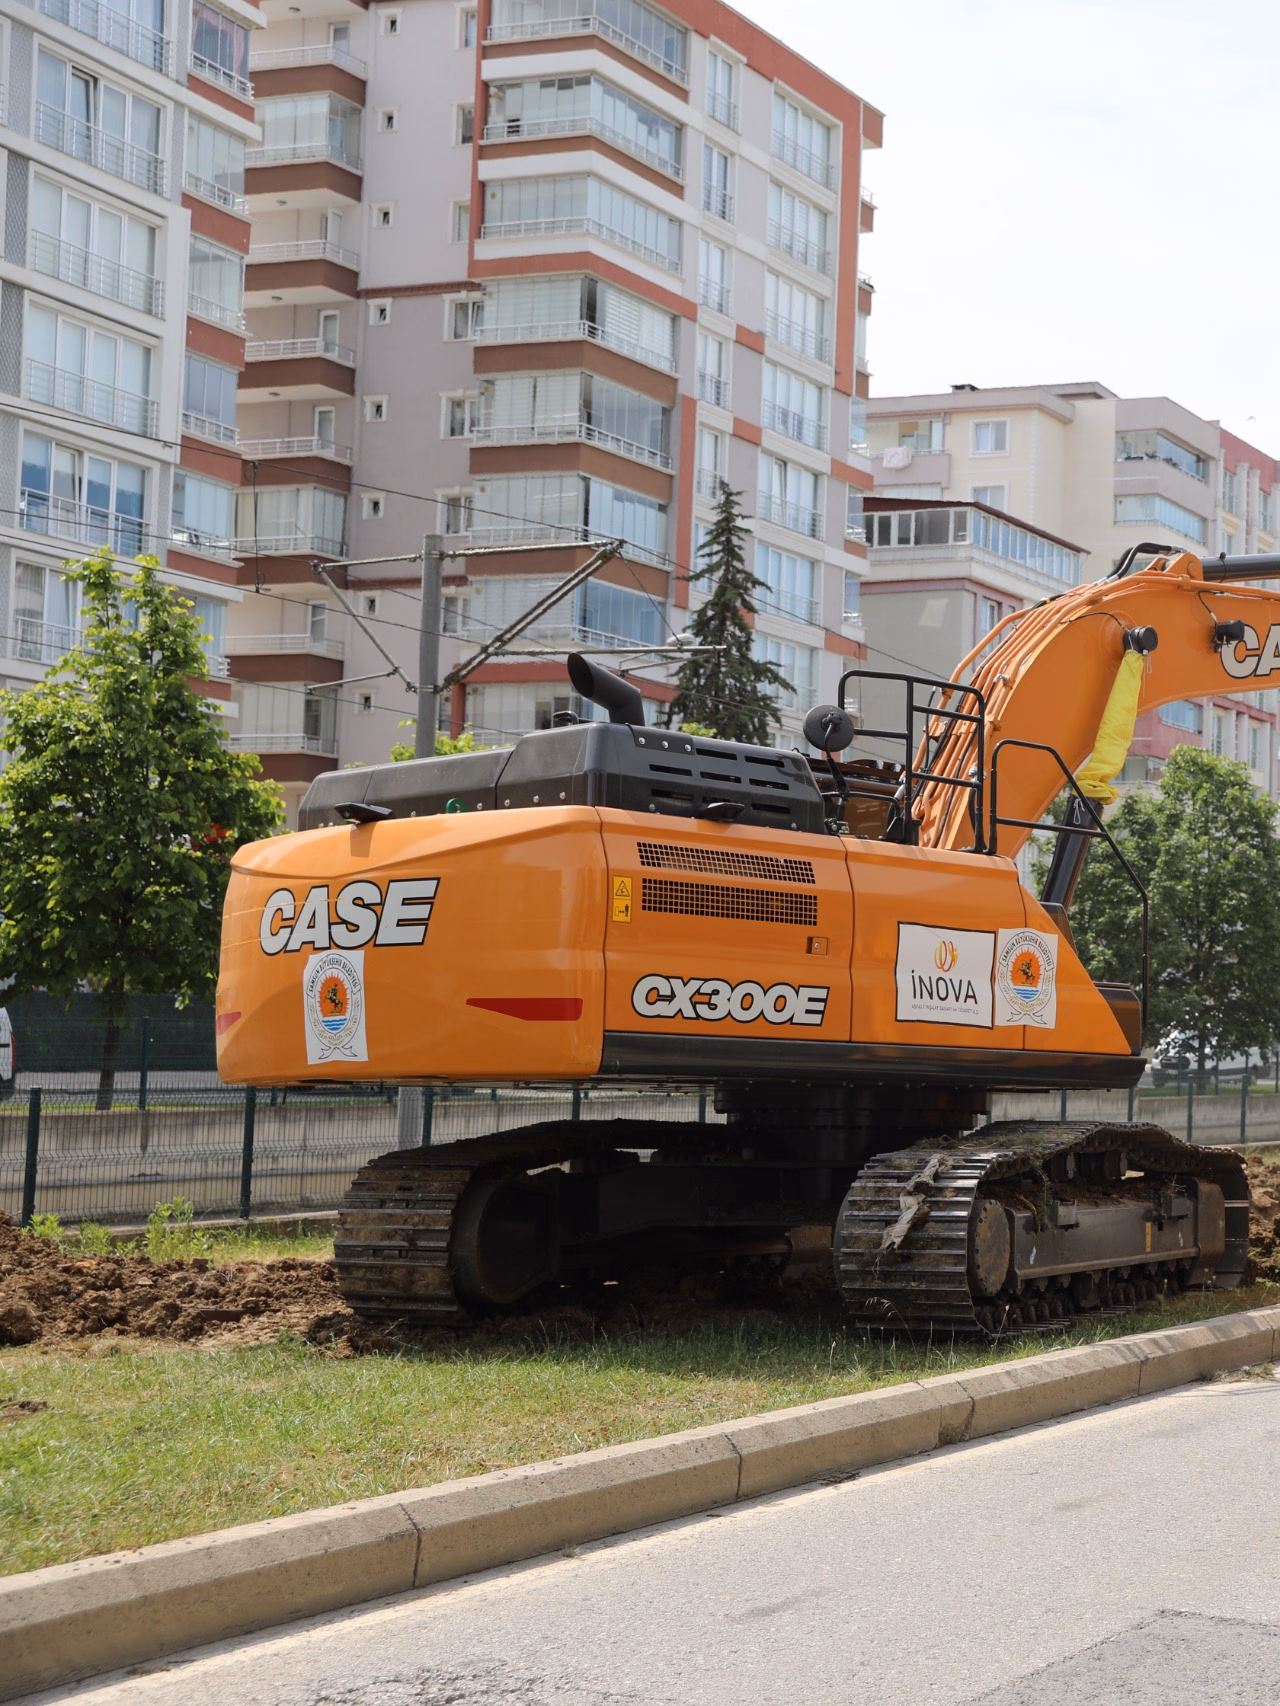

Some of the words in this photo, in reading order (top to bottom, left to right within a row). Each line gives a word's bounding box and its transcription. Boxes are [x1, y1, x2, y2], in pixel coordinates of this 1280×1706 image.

[259, 877, 441, 956] CASE
[308, 968, 321, 993] SAMSUN
[631, 973, 830, 1027] CX300E
[911, 969, 978, 1005] İNOVA
